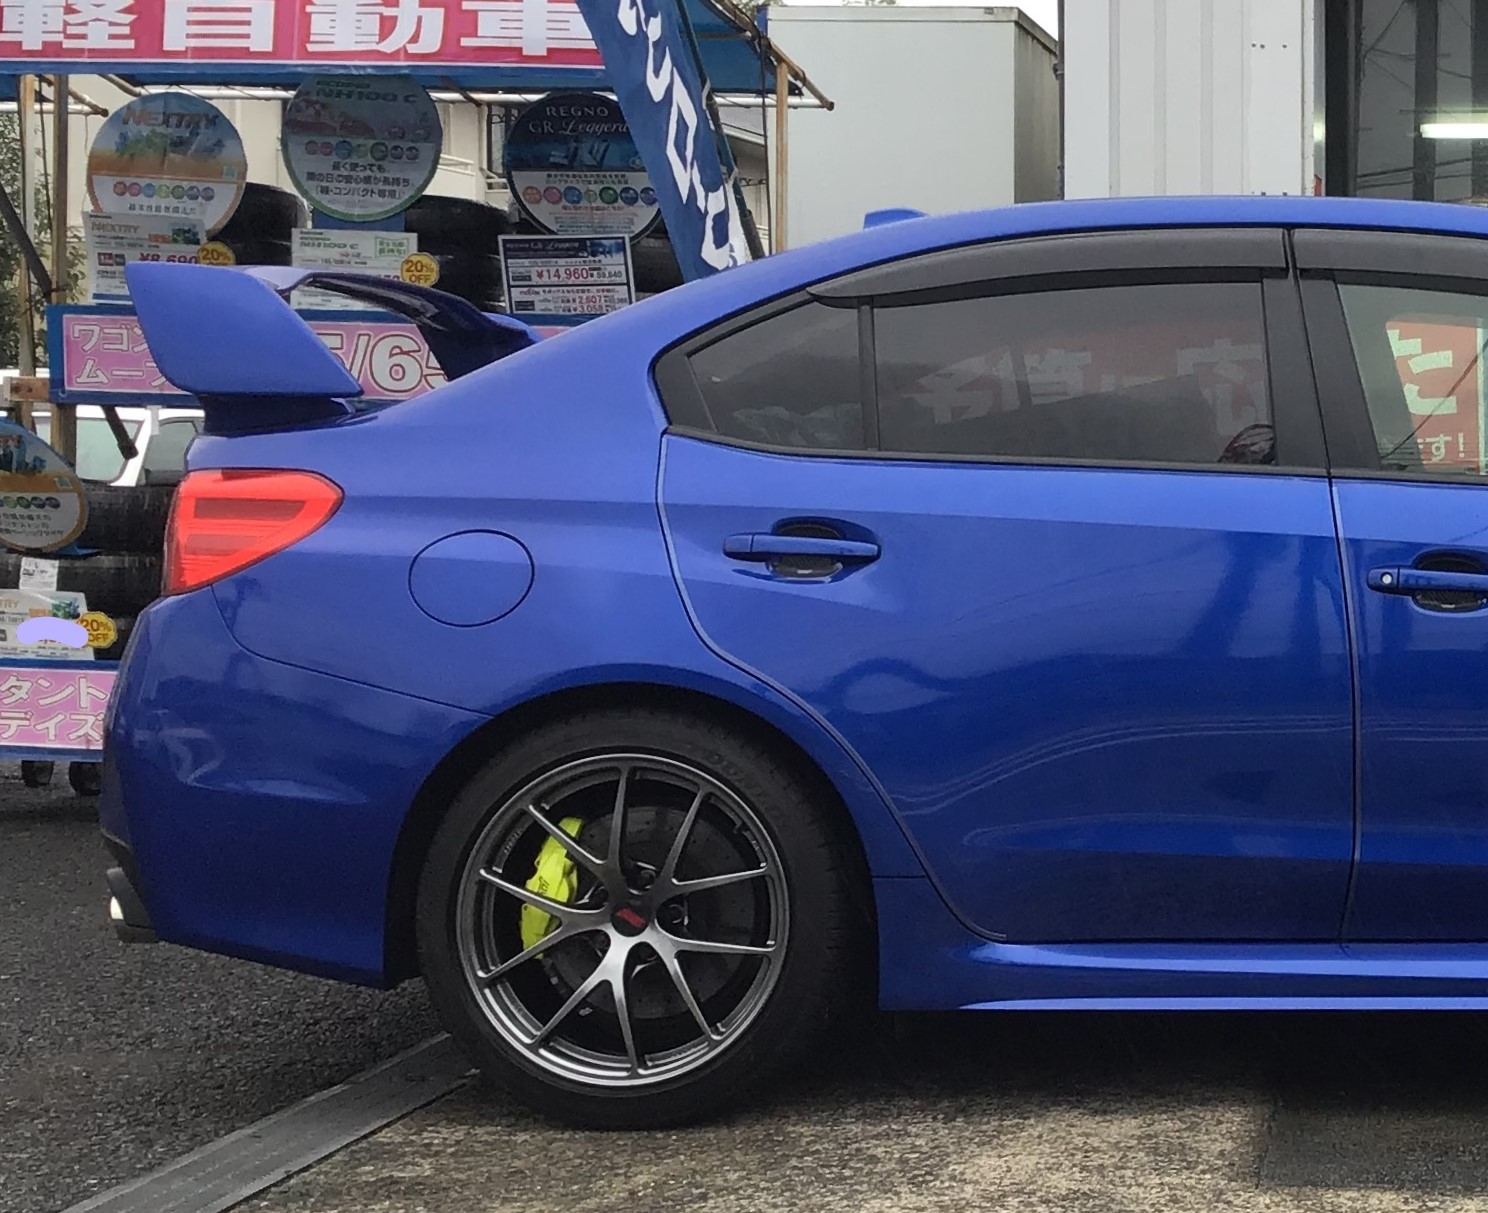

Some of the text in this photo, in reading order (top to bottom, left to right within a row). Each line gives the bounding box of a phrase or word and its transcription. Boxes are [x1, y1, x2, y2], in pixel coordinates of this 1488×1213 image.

[0, 0, 597, 56] 軽自動車
[546, 105, 608, 117] REGNO
[529, 120, 554, 133] GR
[405, 260, 435, 273] 20%
[408, 274, 431, 283] OFF
[0, 674, 109, 710] タント
